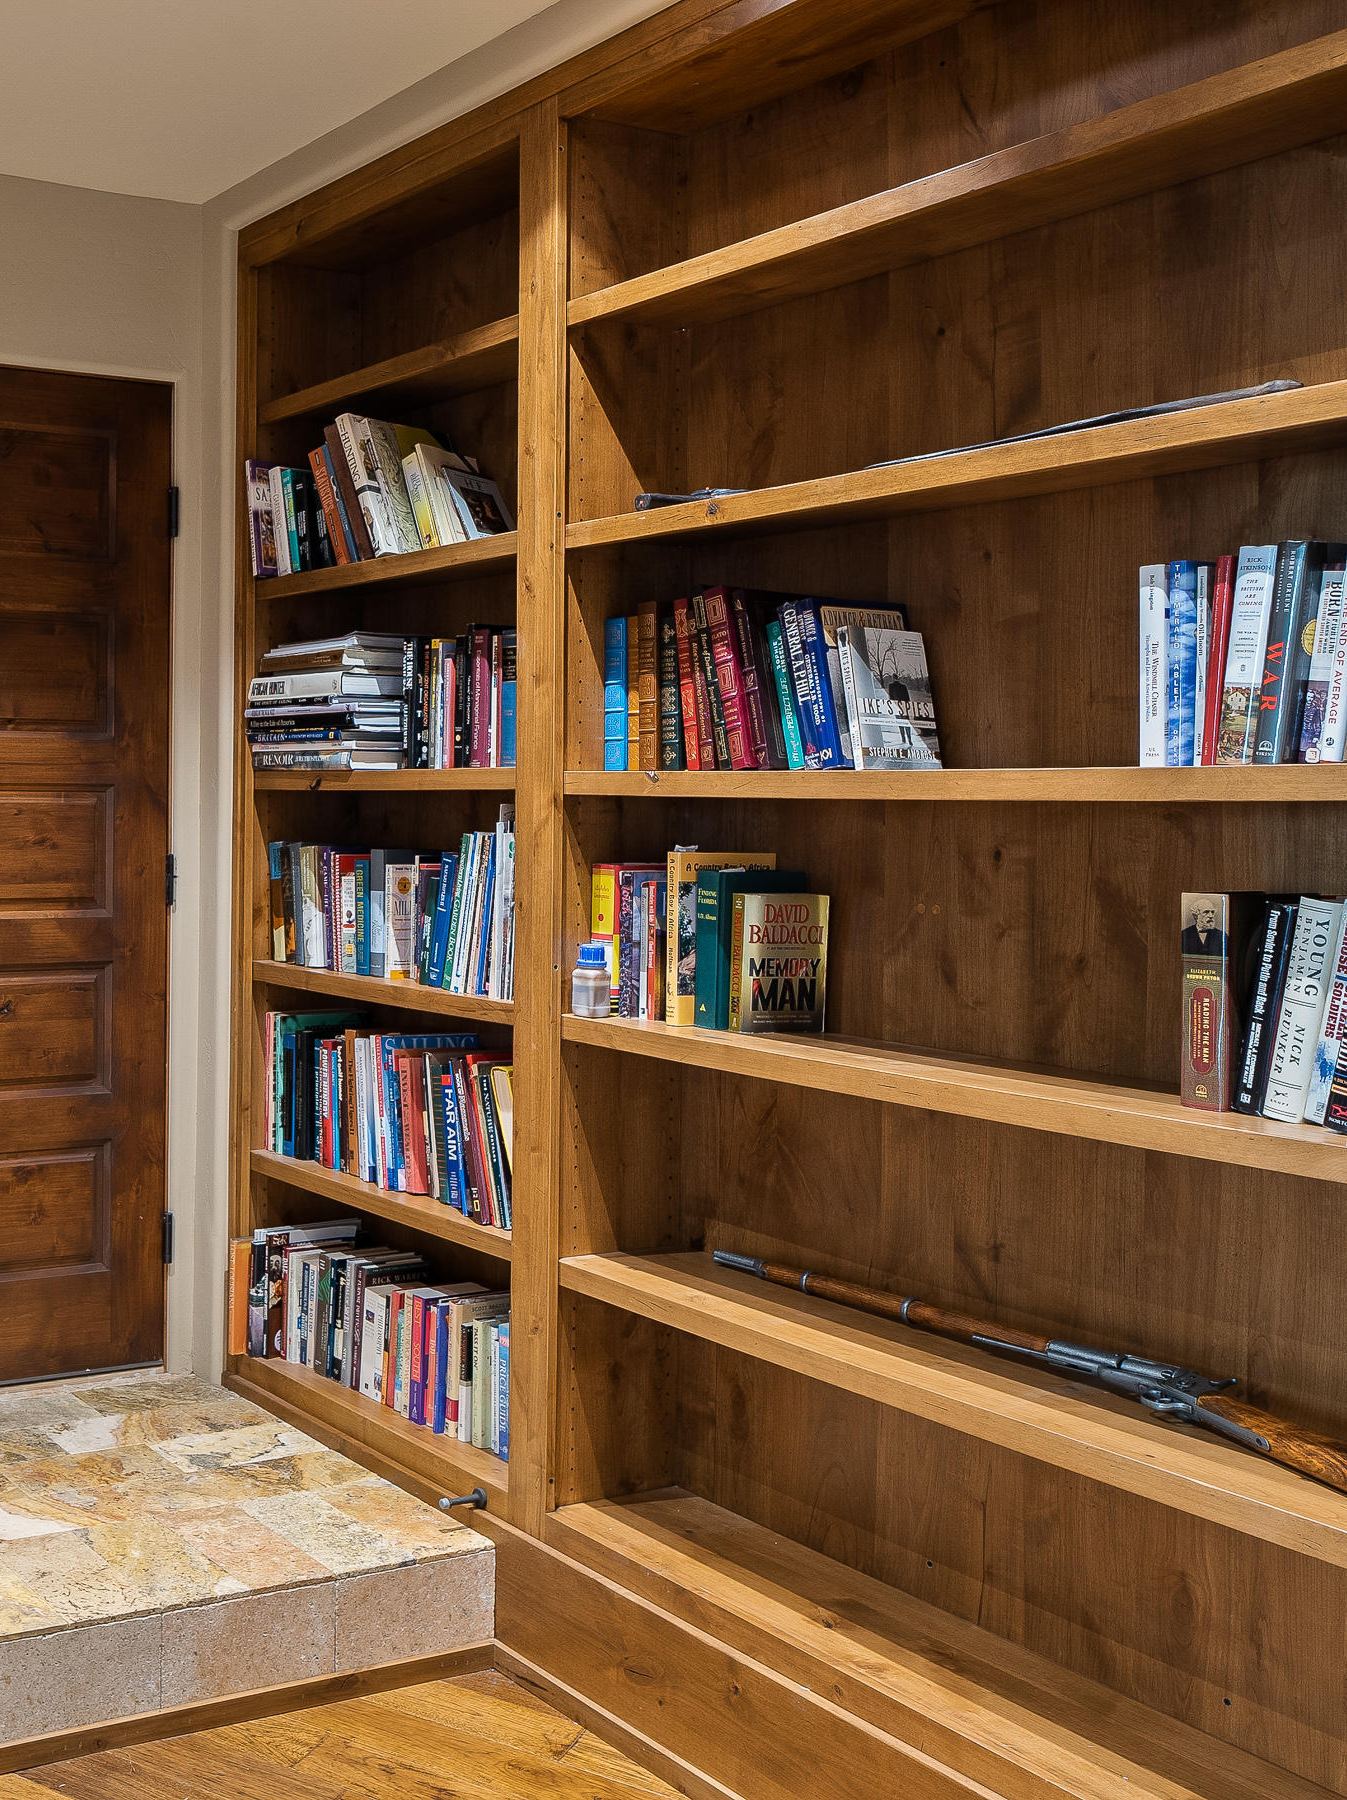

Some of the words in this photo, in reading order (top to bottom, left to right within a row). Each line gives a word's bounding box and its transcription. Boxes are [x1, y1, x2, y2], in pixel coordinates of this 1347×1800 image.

[341, 431, 361, 484] HUNTING
[1287, 550, 1296, 580] ROBERT
[1283, 583, 1293, 613] GREENE
[1327, 581, 1342, 618] BORN
[1173, 594, 1181, 649] EMERALD
[784, 609, 800, 660] GENERAL
[794, 679, 809, 705] HILL
[1151, 641, 1160, 655] THE
[1337, 650, 1345, 666] OF
[268, 681, 285, 695] HUNTER
[1151, 657, 1160, 690] WINDMILL
[1259, 642, 1284, 710] WAR
[862, 699, 893, 714] IKE'S
[897, 700, 929, 717] SPIES
[1151, 691, 1160, 717] CHASER
[1328, 670, 1342, 725] AVERAGE
[263, 754, 293, 766] RENOIR
[868, 746, 899, 757] STEPHEN
[907, 748, 937, 761] AMBROSE
[356, 870, 364, 897] GREEN
[764, 903, 810, 923] DAVID
[1270, 910, 1280, 928] From
[447, 937, 455, 962] BOOK
[749, 924, 824, 945] BALDACCI
[1265, 928, 1278, 954] Soviet
[733, 942, 742, 995] BALDACCI
[749, 958, 821, 978] MEMORY
[1293, 918, 1313, 993] BENJAMIN
[1304, 920, 1330, 997] YOUNG
[752, 978, 817, 1012] MAN
[1254, 998, 1263, 1014] Back
[1324, 983, 1343, 1039] SOLDIERS
[1271, 1009, 1292, 1074] BUNKER
[1290, 1025, 1305, 1066] NICK
[447, 1127, 457, 1161] AIM
[372, 1277, 392, 1285] RICK
[412, 1342, 421, 1380] SOUTH
